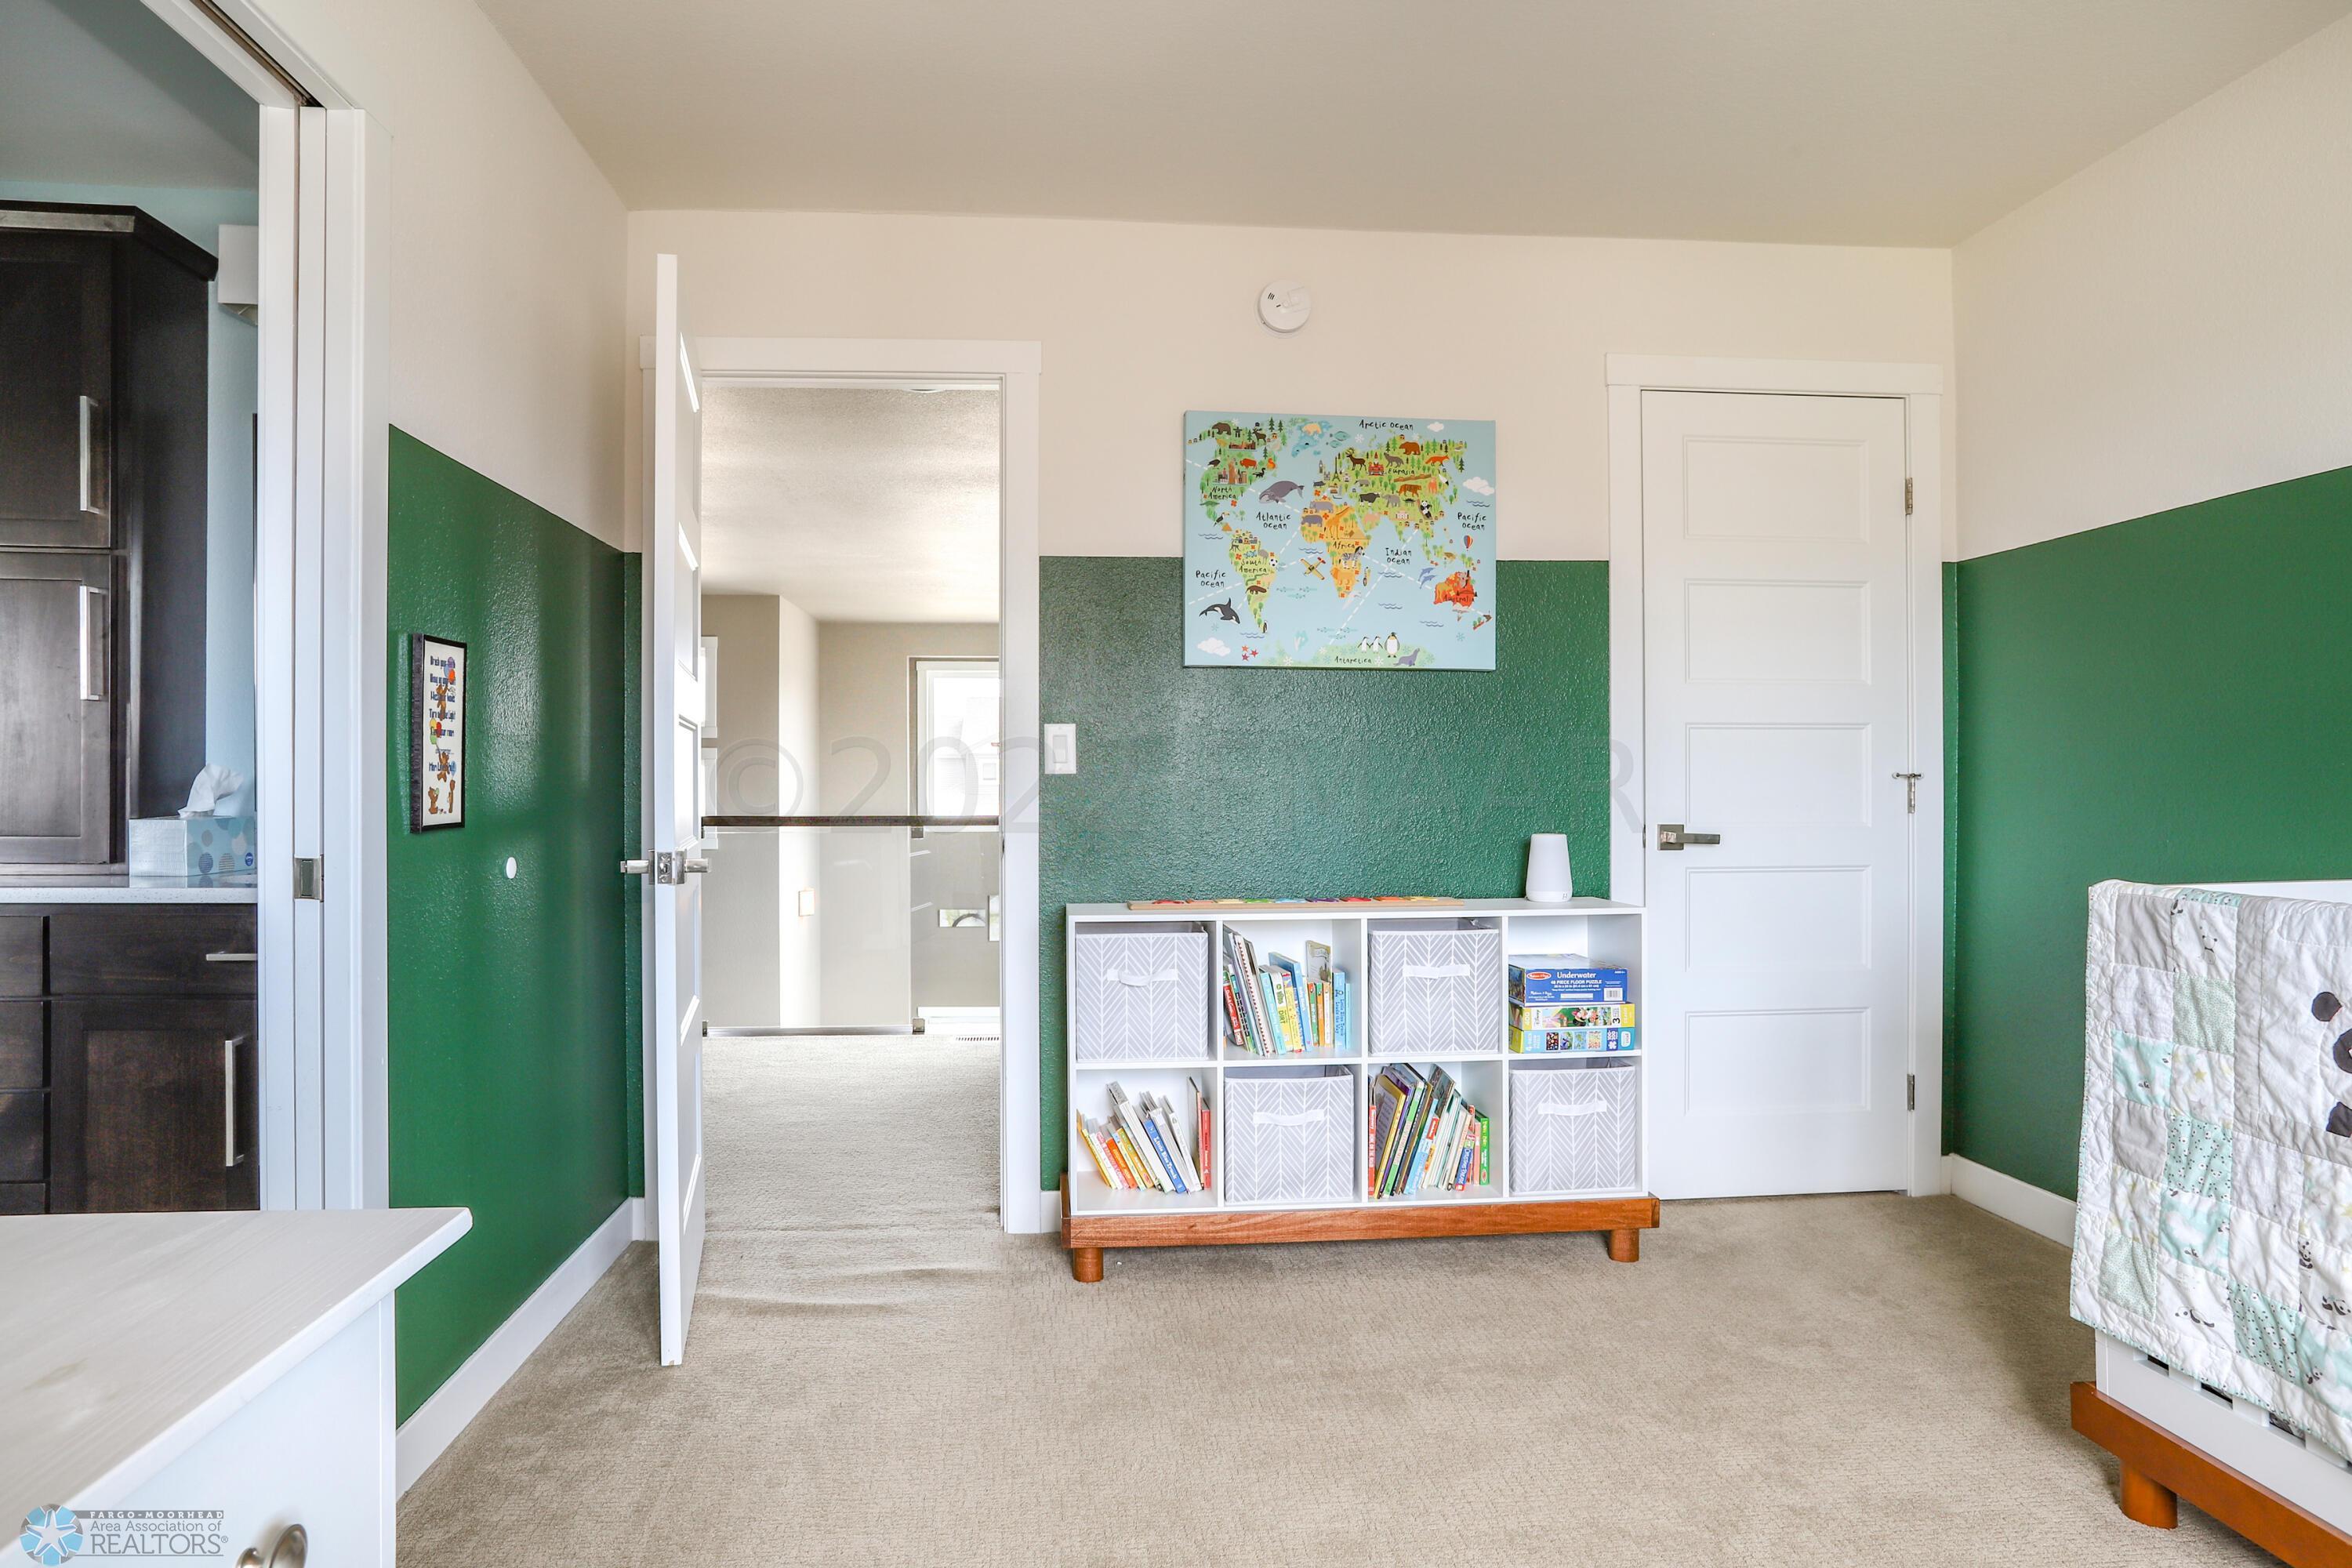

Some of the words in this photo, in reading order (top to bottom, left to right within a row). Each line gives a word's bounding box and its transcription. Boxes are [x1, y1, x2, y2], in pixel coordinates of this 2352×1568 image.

[1359, 419, 1387, 430] Arctic
[1208, 492, 1237, 500] America
[1256, 511, 1291, 522] Atlantic
[1457, 511, 1486, 524] Pacific
[1333, 540, 1356, 550] Africa
[1385, 547, 1412, 557] Indian
[1239, 565, 1268, 574] America
[1196, 570, 1226, 580] Pacific
[1334, 655, 1372, 664] Antarctica
[1153, 1136, 1164, 1152] Little
[1160, 1151, 1169, 1163] Blue
[1165, 1163, 1178, 1180] Truck
